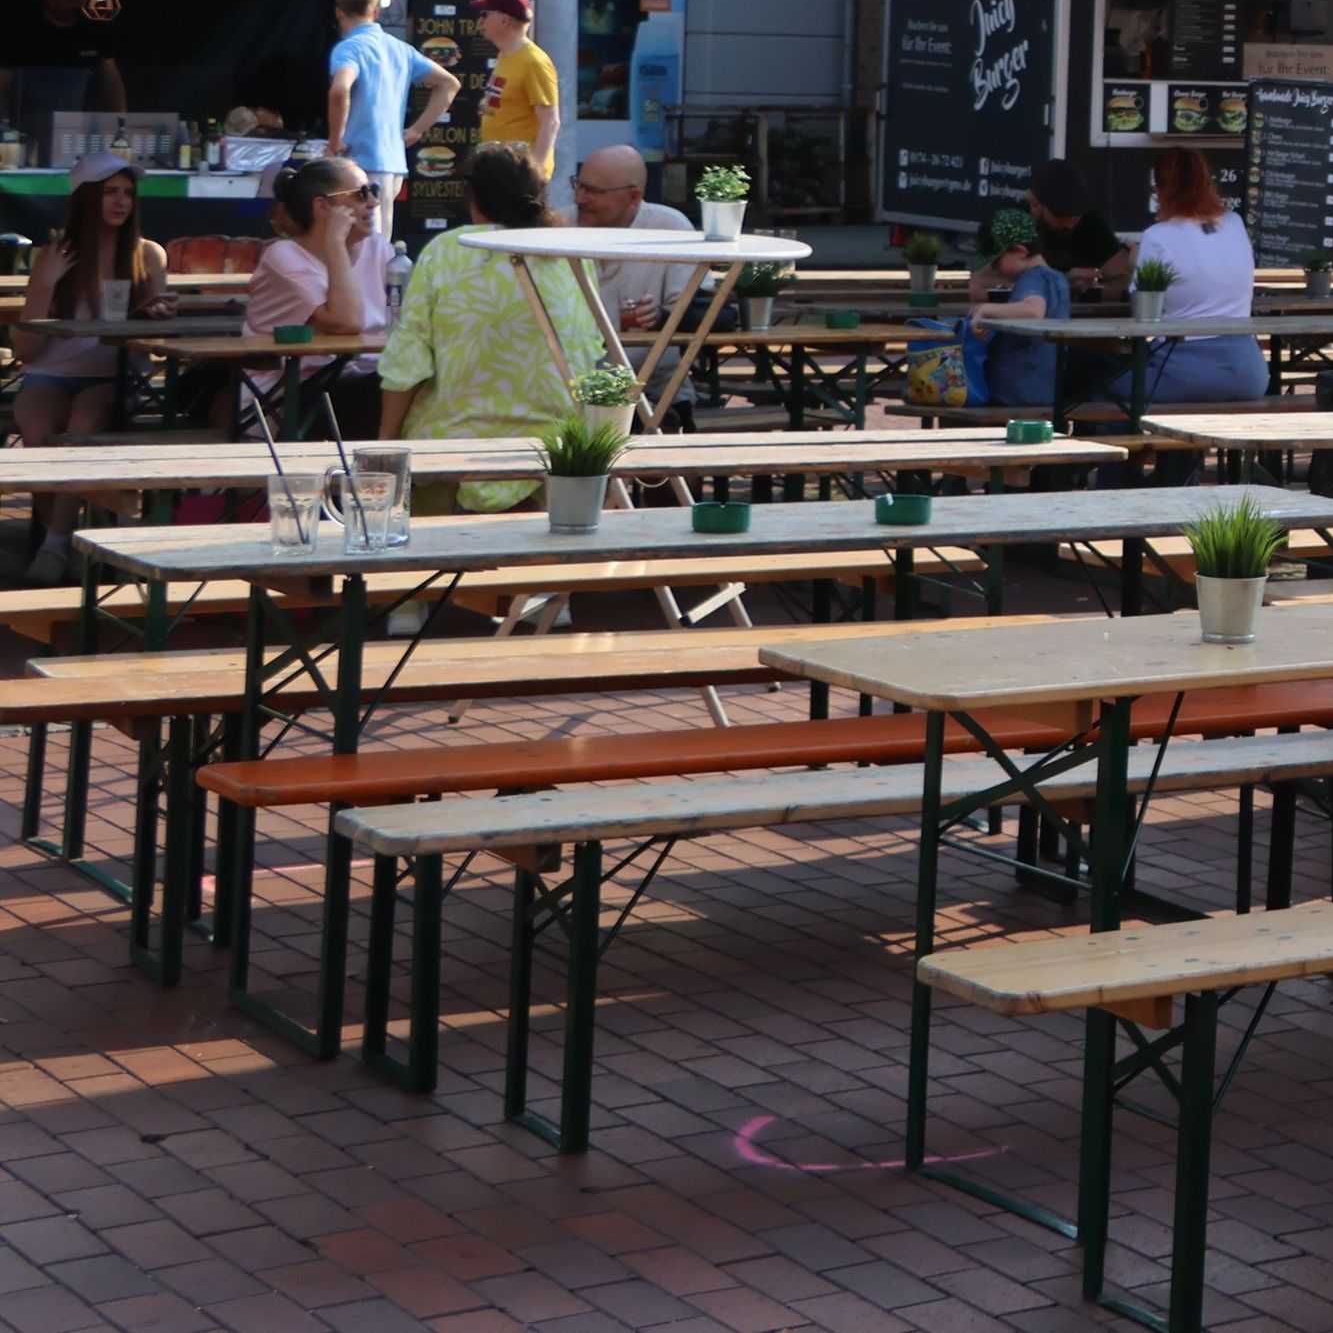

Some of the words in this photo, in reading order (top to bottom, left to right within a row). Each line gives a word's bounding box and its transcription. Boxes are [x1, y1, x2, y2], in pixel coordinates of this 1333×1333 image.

[417, 17, 454, 35] JOHN
[969, 39, 1029, 111] Burger
[1220, 169, 1237, 183] 26
